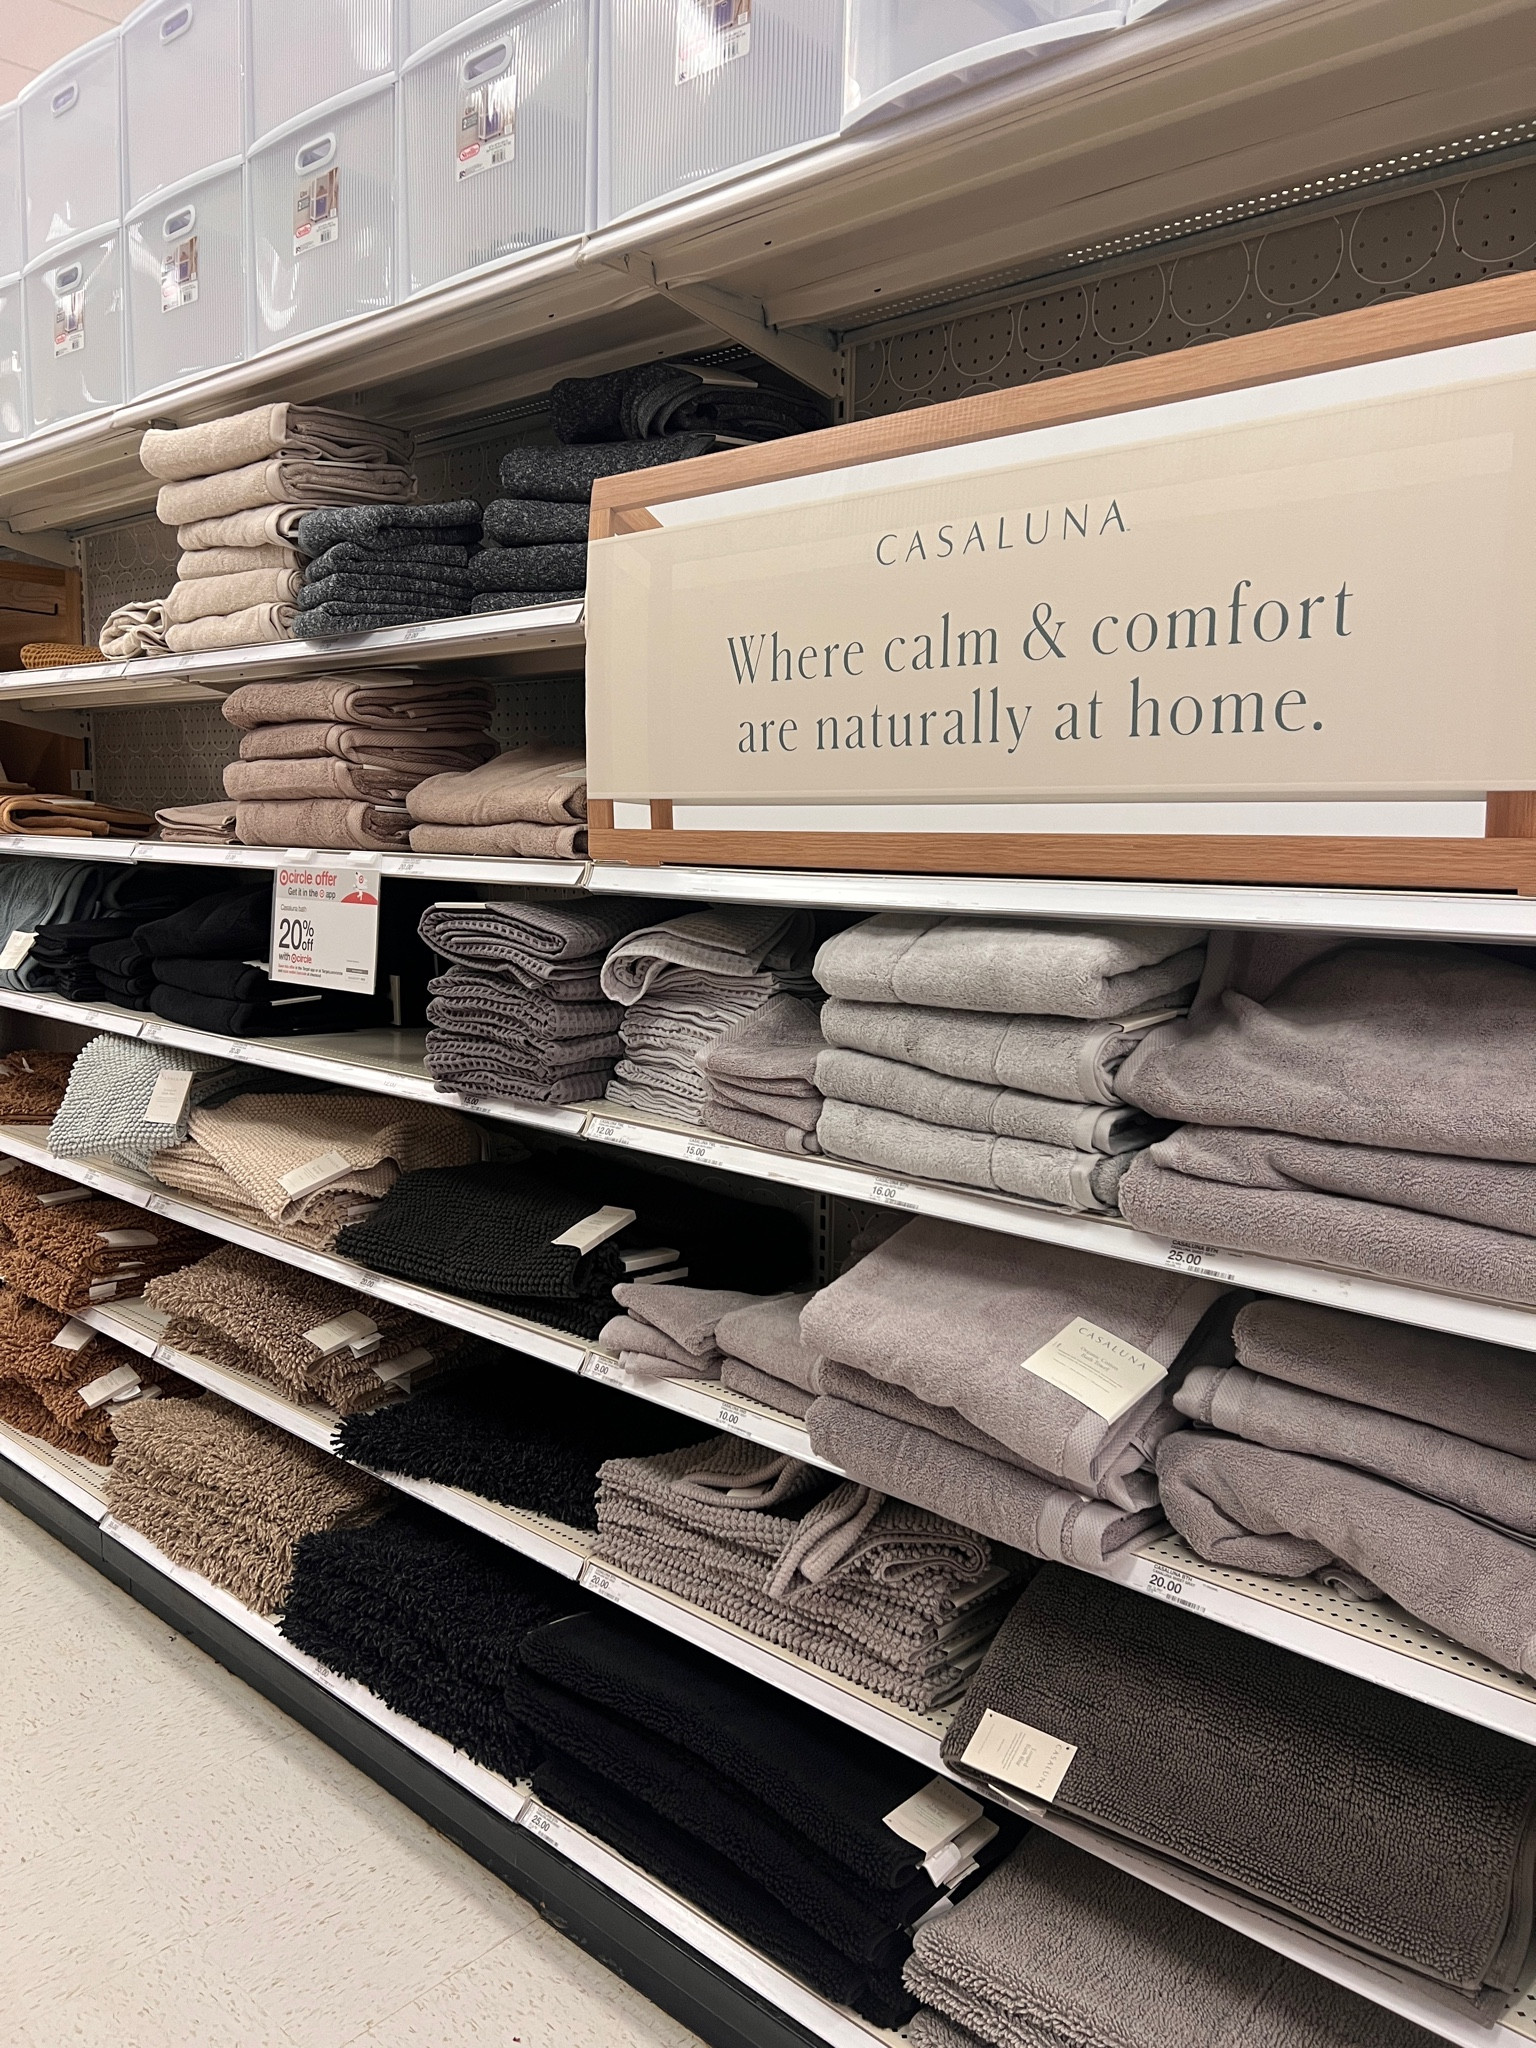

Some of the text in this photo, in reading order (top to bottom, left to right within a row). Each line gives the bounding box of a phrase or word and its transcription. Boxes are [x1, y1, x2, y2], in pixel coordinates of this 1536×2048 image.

[875, 499, 1127, 566] CASALUNA
[727, 580, 1354, 685] Where calm & comfort
[737, 676, 1325, 754] are naturally at home.
[288, 869, 338, 886] circle offer
[287, 887, 297, 896] Get
[303, 888, 308, 897] in
[309, 889, 318, 898] the
[325, 891, 336, 900] app
[302, 938, 314, 951] off
[278, 952, 313, 964] with circle
[596, 1126, 615, 1136] 12.00
[686, 1145, 706, 1156] 15.00
[872, 1185, 896, 1198] 16.00
[1167, 1249, 1202, 1266] 25.00
[1078, 1327, 1146, 1371] CASALUNA
[593, 1363, 609, 1375] 9.00
[719, 1410, 739, 1424] 10.00
[590, 1574, 610, 1590] 20.00
[1149, 1574, 1183, 1594] 20.00
[531, 1814, 551, 1832] 25.00
